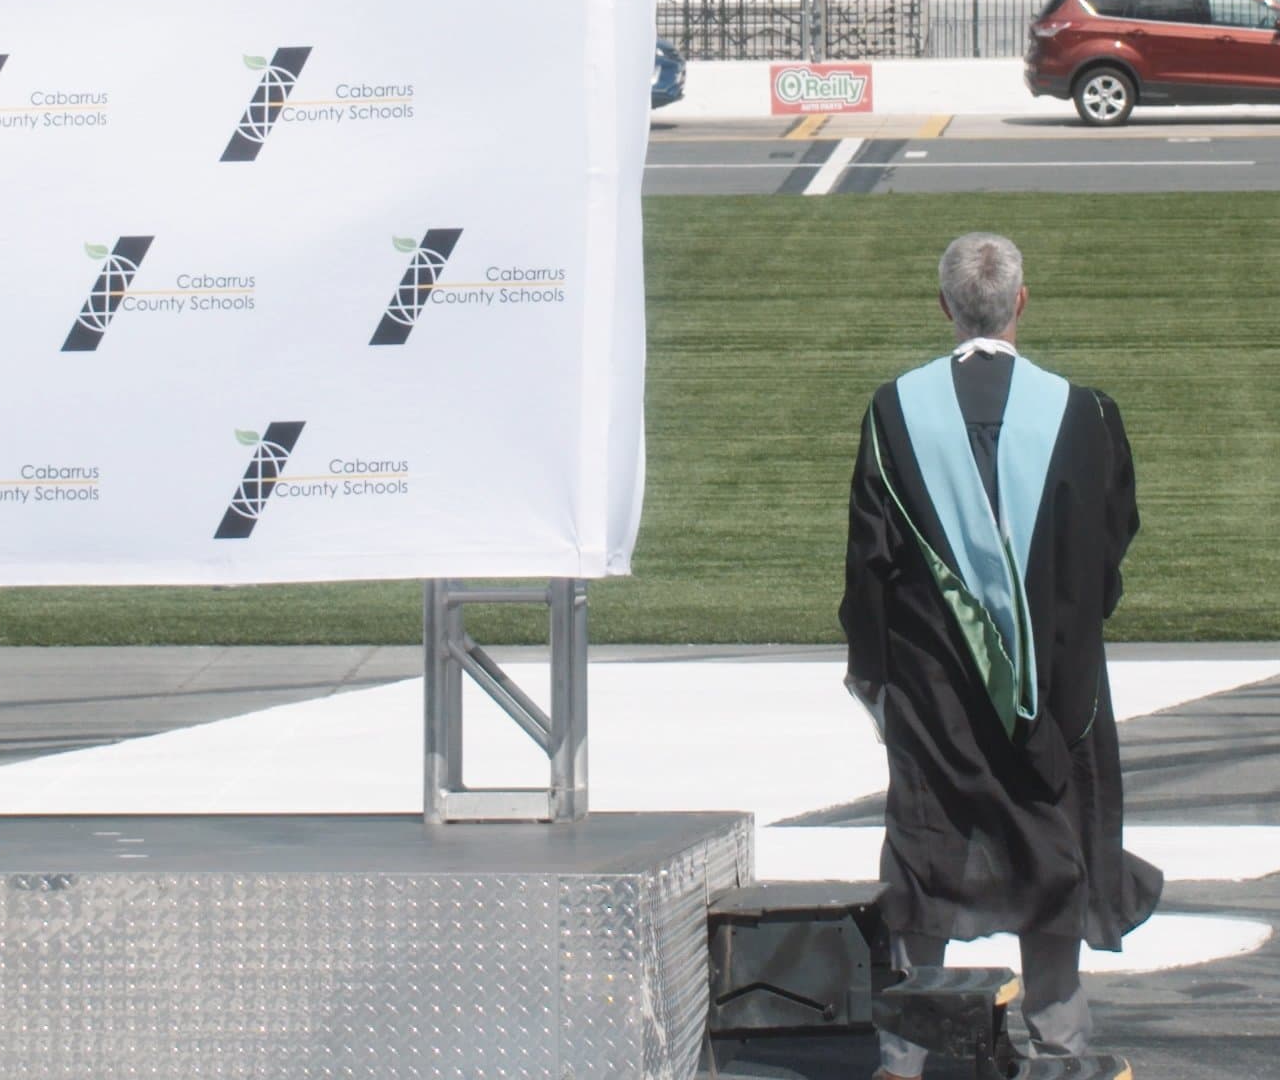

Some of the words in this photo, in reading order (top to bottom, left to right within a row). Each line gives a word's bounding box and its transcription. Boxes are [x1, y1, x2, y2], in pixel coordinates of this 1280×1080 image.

[336, 84, 413, 98] Cabarrus
[780, 71, 862, 100] O'Reilly
[31, 92, 107, 105] Cabarrus
[44, 112, 106, 126] Schools
[282, 103, 344, 122] County
[349, 104, 413, 119] Schools
[177, 274, 255, 288] Cabarrus
[486, 267, 564, 281] Cabarrus
[121, 293, 184, 312] County
[190, 296, 254, 310] Schools
[431, 286, 494, 305] County
[500, 288, 564, 303] Schools
[21, 465, 99, 479] Cabarrus
[329, 459, 408, 473] Cabarrus
[35, 486, 99, 501] Schools
[273, 479, 337, 498] County
[344, 480, 407, 495] Schools
